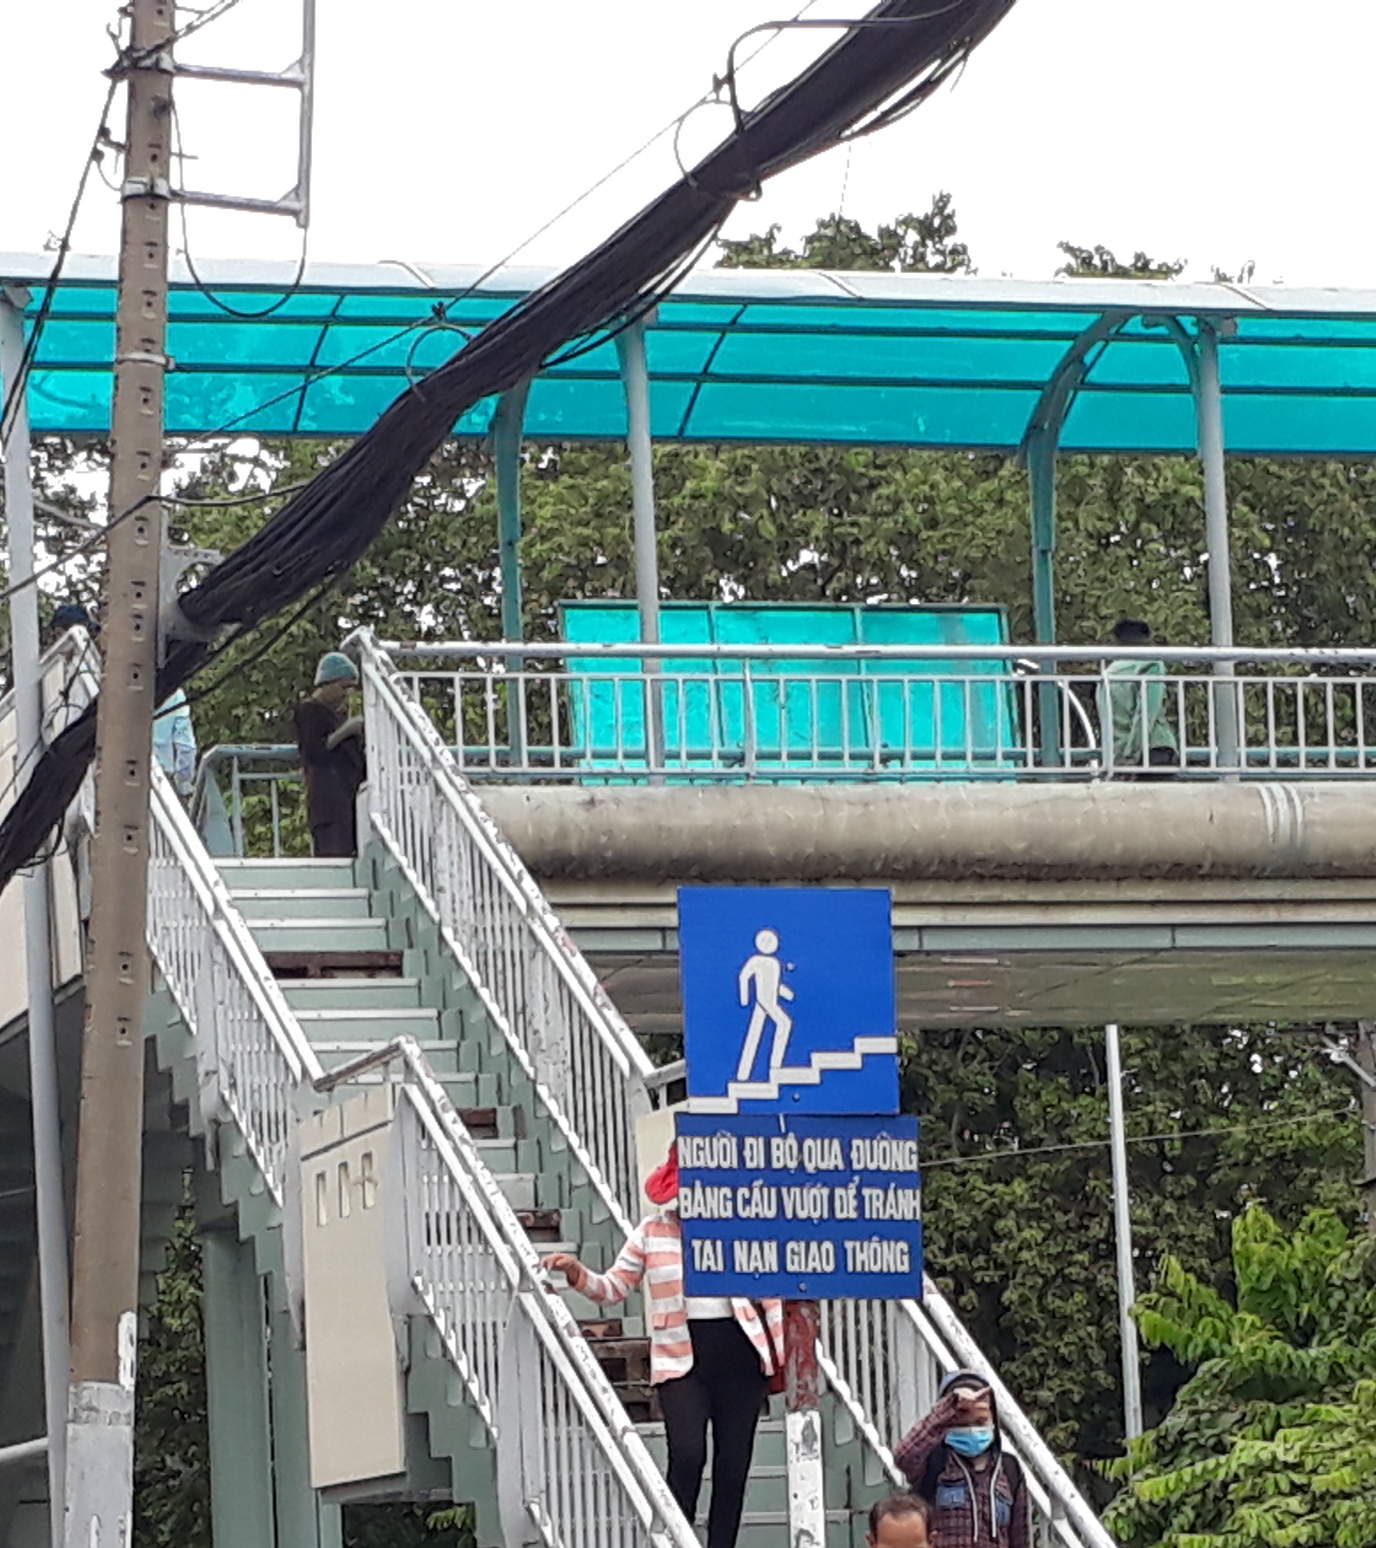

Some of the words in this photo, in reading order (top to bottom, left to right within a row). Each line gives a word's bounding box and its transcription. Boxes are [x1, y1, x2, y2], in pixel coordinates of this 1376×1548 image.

[742, 1136, 765, 1170] ĐI
[771, 1131, 800, 1174] BỘ
[803, 1137, 844, 1174] QUA
[862, 1182, 921, 1221] TRÁNH
[691, 1239, 724, 1273] TAI
[733, 1240, 779, 1279] NẠN
[786, 1240, 835, 1274] GIAO
[844, 1235, 910, 1274] THÔNG
